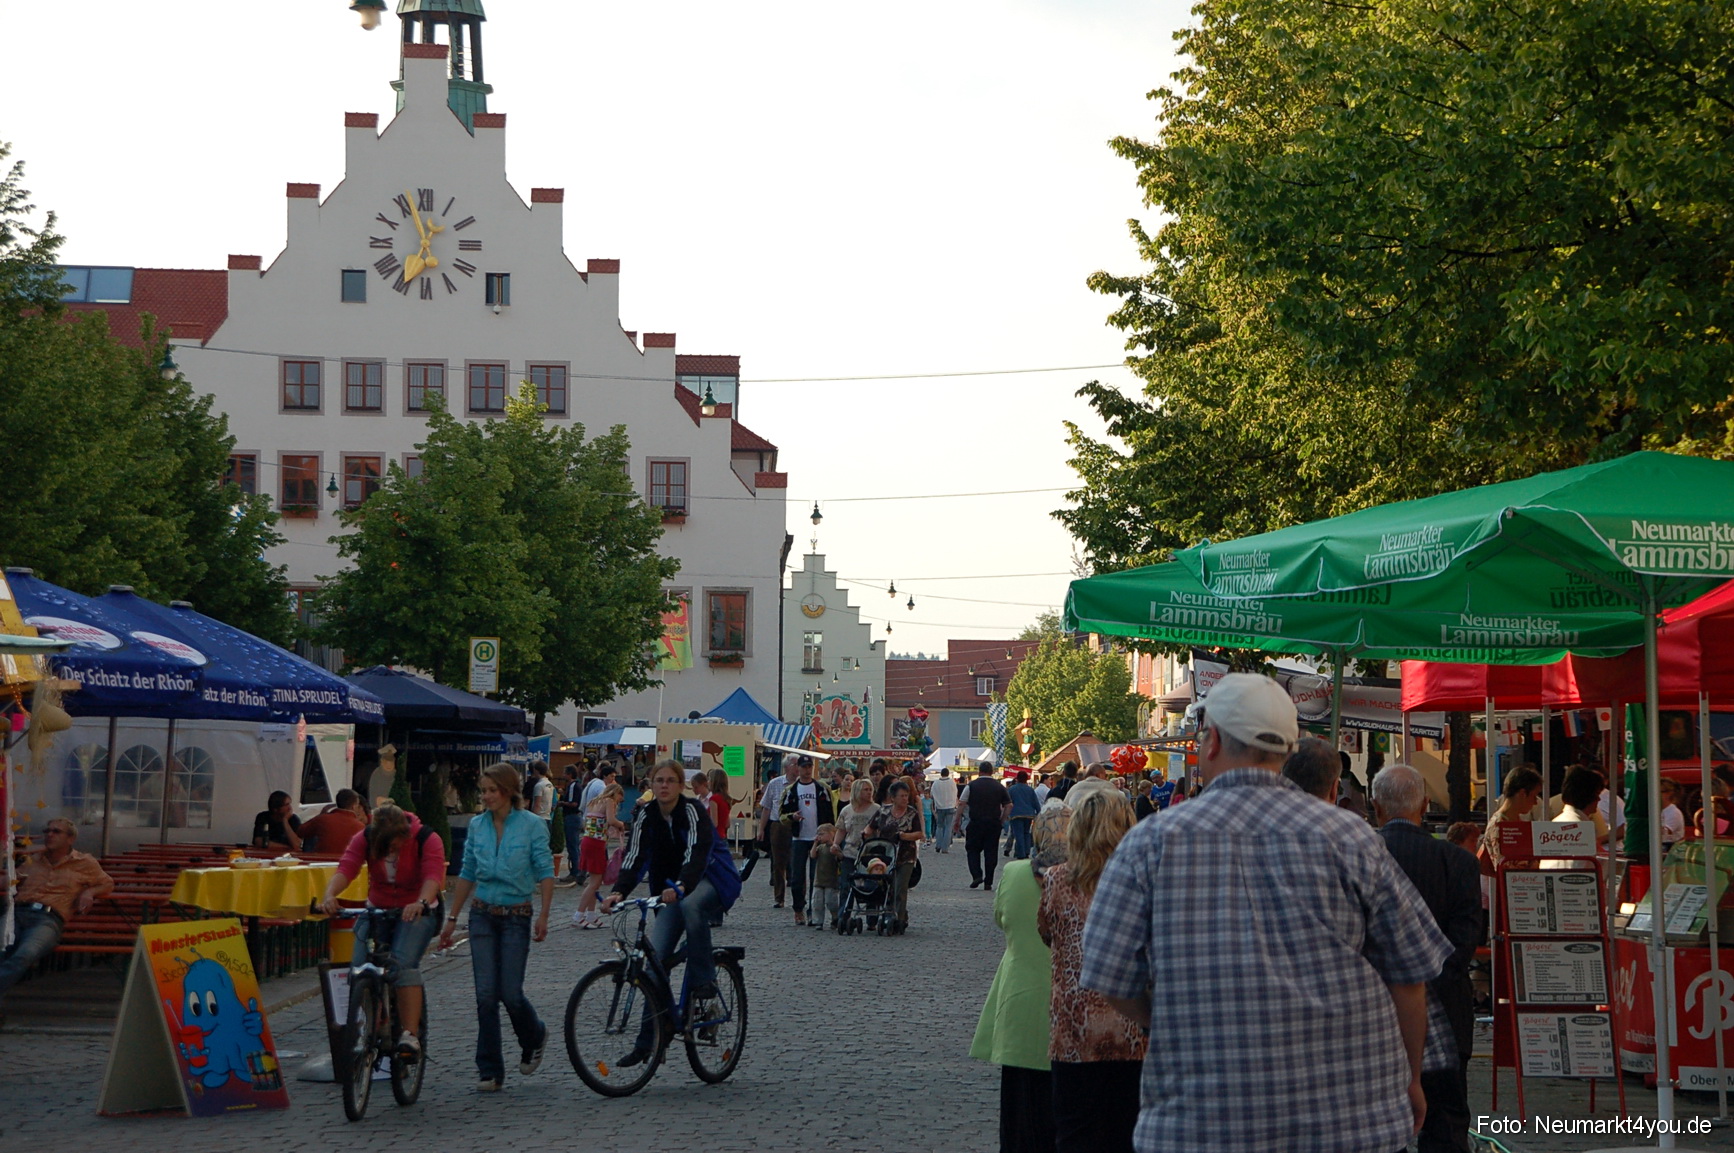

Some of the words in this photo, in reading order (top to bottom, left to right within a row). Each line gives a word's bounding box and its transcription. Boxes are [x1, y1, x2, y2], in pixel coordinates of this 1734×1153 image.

[1378, 524, 1442, 552] Neumarkter
[1219, 549, 1270, 571] Neumarkter
[1363, 543, 1456, 580] Lammsbräu
[1169, 590, 1264, 611] Neumarkter
[1149, 601, 1283, 634] Lammsbräu
[1460, 613, 1560, 630] Neumarkter
[1440, 624, 1579, 646] Lammsbräu
[479, 646, 490, 657] H
[63, 666, 87, 684] Der
[87, 669, 131, 688] Schatz
[132, 672, 155, 690] der
[157, 673, 195, 692] Rhön.
[204, 688, 219, 704] atz
[220, 688, 237, 704] der
[299, 690, 343, 705] SPRUDEL
[1539, 831, 1583, 845] Bögerl
[1690, 1074, 1718, 1086] Ober
